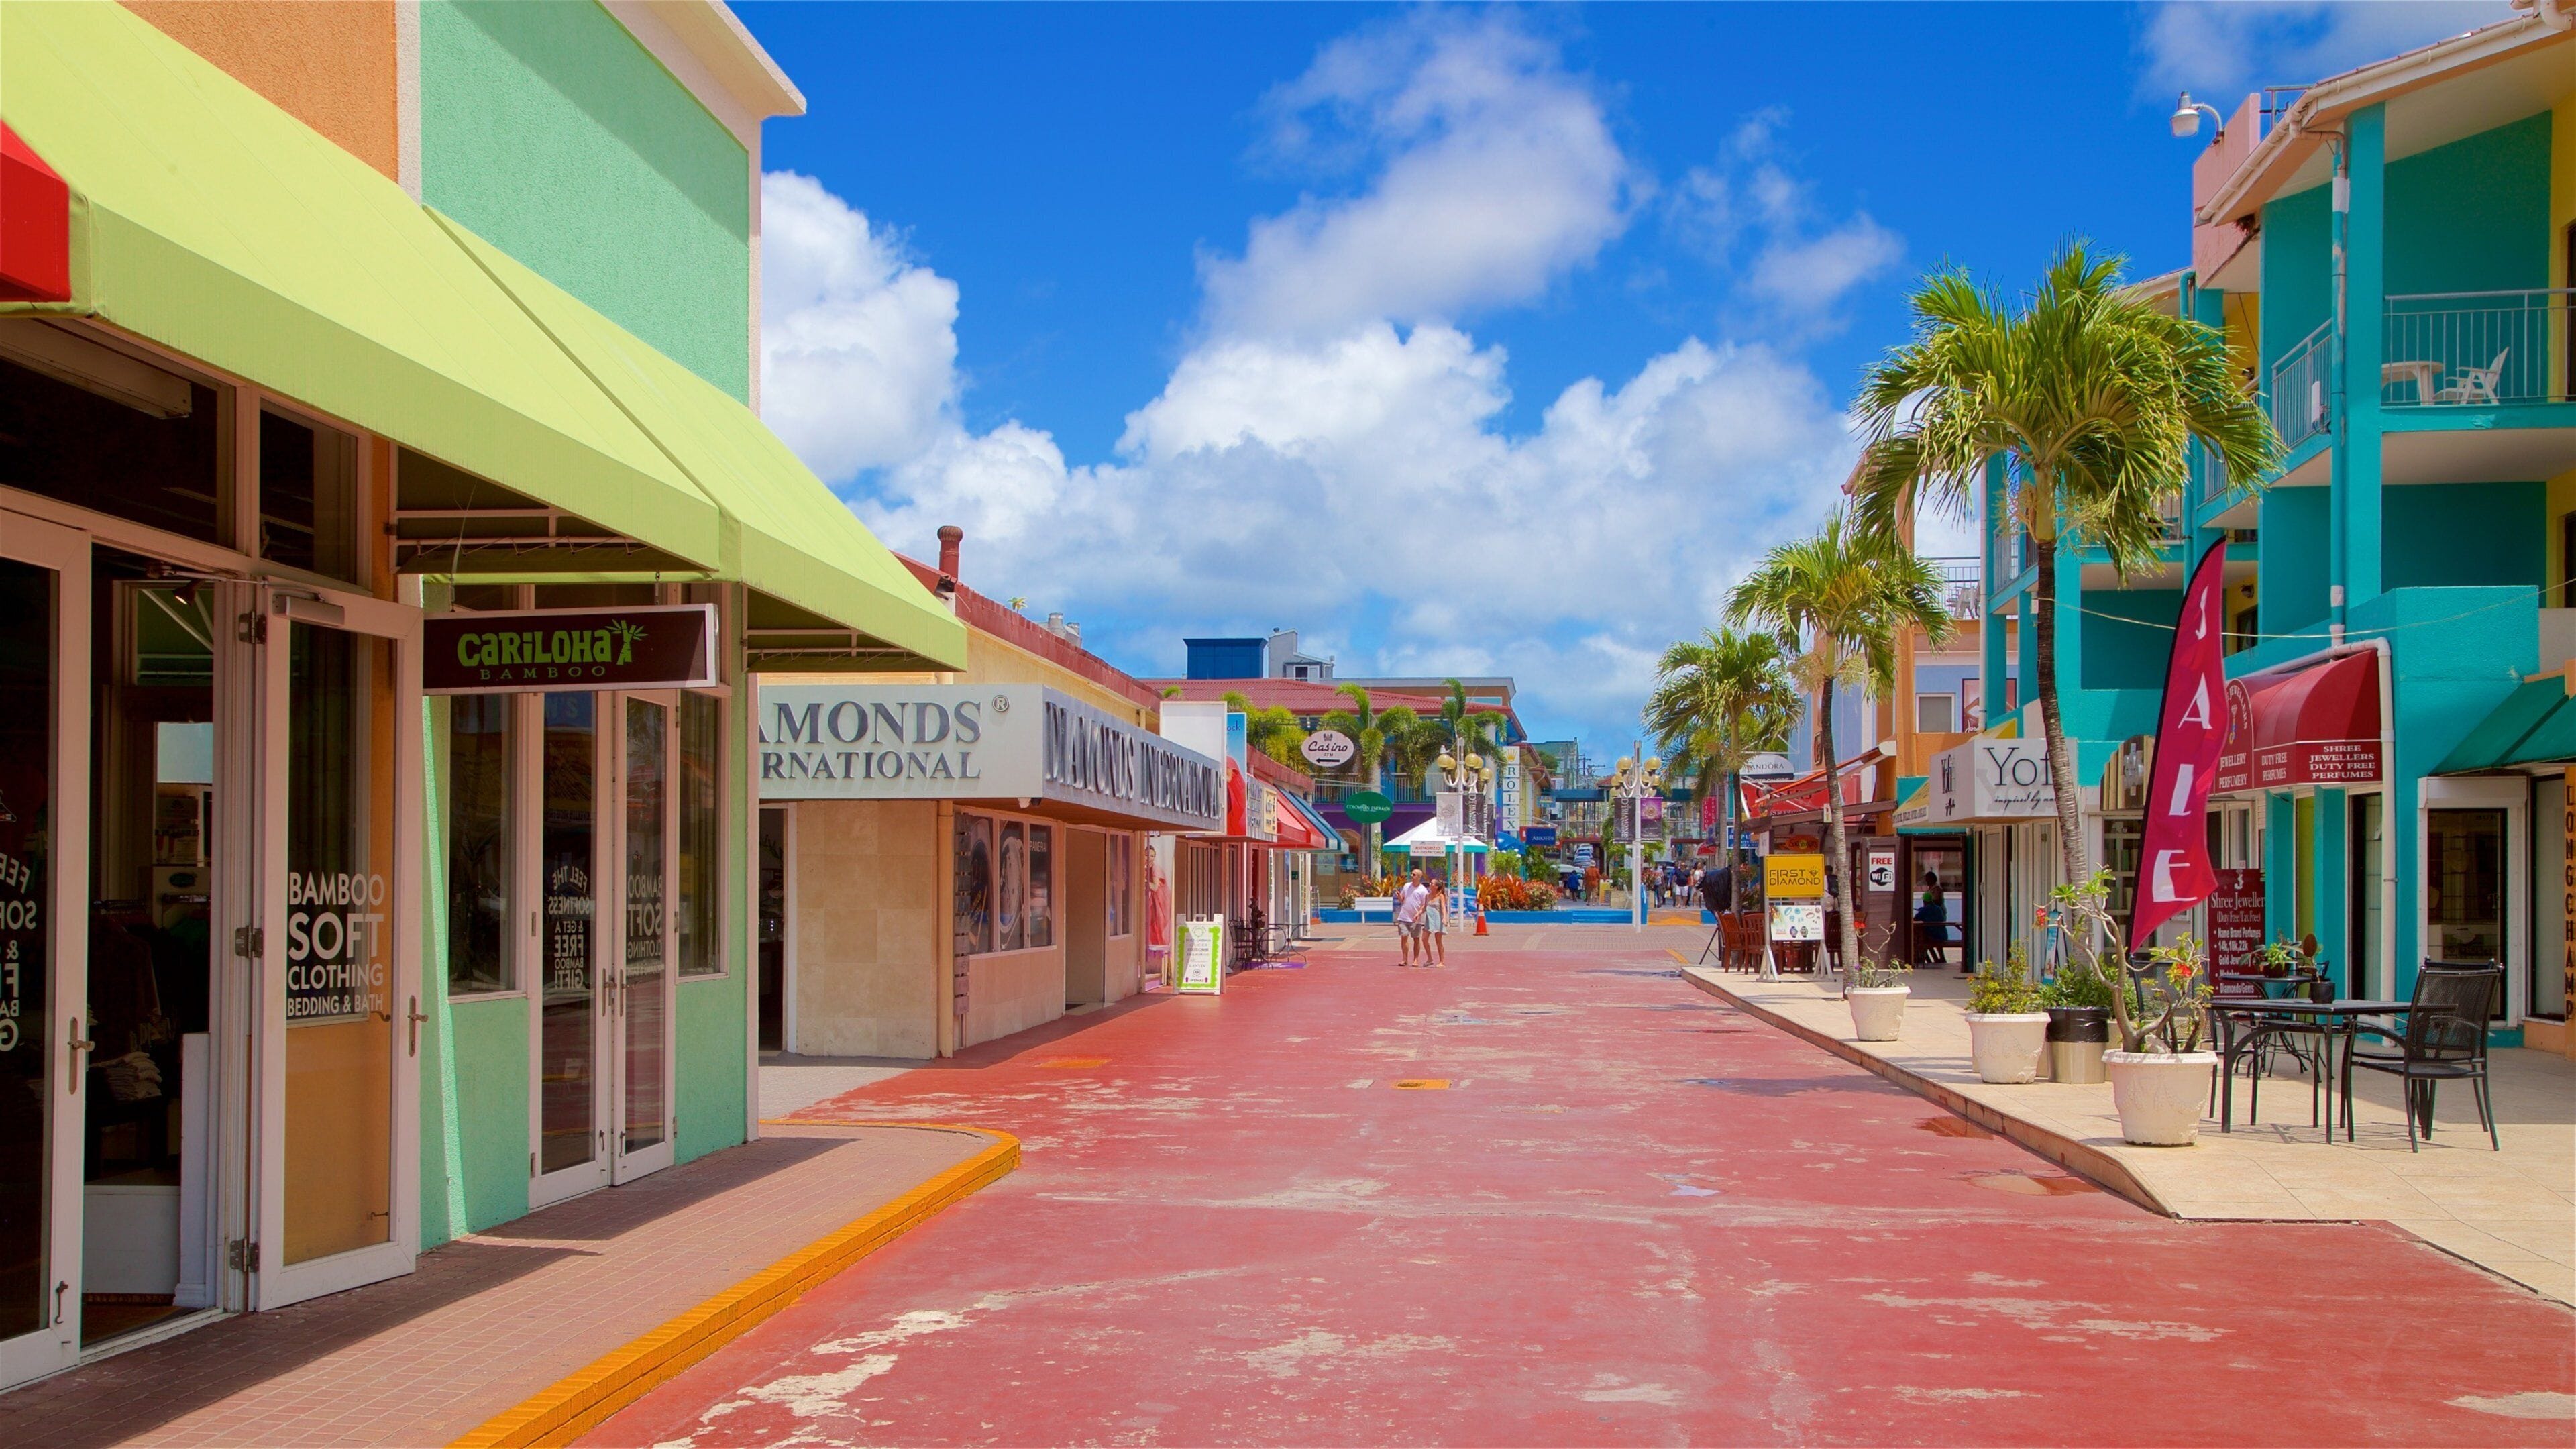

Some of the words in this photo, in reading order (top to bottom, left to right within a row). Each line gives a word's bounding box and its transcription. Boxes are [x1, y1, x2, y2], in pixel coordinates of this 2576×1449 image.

[480, 666, 606, 680] BAMBOO
[1044, 701, 1135, 801] DIAMONDS
[1308, 741, 1348, 752] Casino
[2153, 586, 2212, 902] SALE
[761, 751, 981, 780] RNATIONAL
[2220, 753, 2246, 771] JEWELLERY
[2261, 754, 2275, 766] DUTY
[2275, 752, 2288, 764] FREE
[2309, 753, 2374, 763] JEWELLERS
[1983, 747, 2054, 786] Yof
[2263, 768, 2287, 781] PERFUMES
[2310, 763, 2343, 771] DUTY
[2219, 773, 2247, 789] PERFUMERY
[2312, 771, 2373, 779] PERFUMES
[1507, 766, 1516, 830] ROLEX
[1770, 869, 1805, 877] FIRST
[1770, 877, 1821, 885] DIAMOND
[289, 871, 384, 906] BAMBOO
[2211, 892, 2233, 908] Shree
[2565, 785, 2575, 1021] LONGCHAMP
[288, 912, 384, 961] SOFT
[2219, 954, 2229, 965] Gold
[288, 963, 384, 991] CLOTHING
[287, 995, 339, 1017] BEDDING
[343, 994, 351, 1013] &
[354, 994, 383, 1012] BATH
